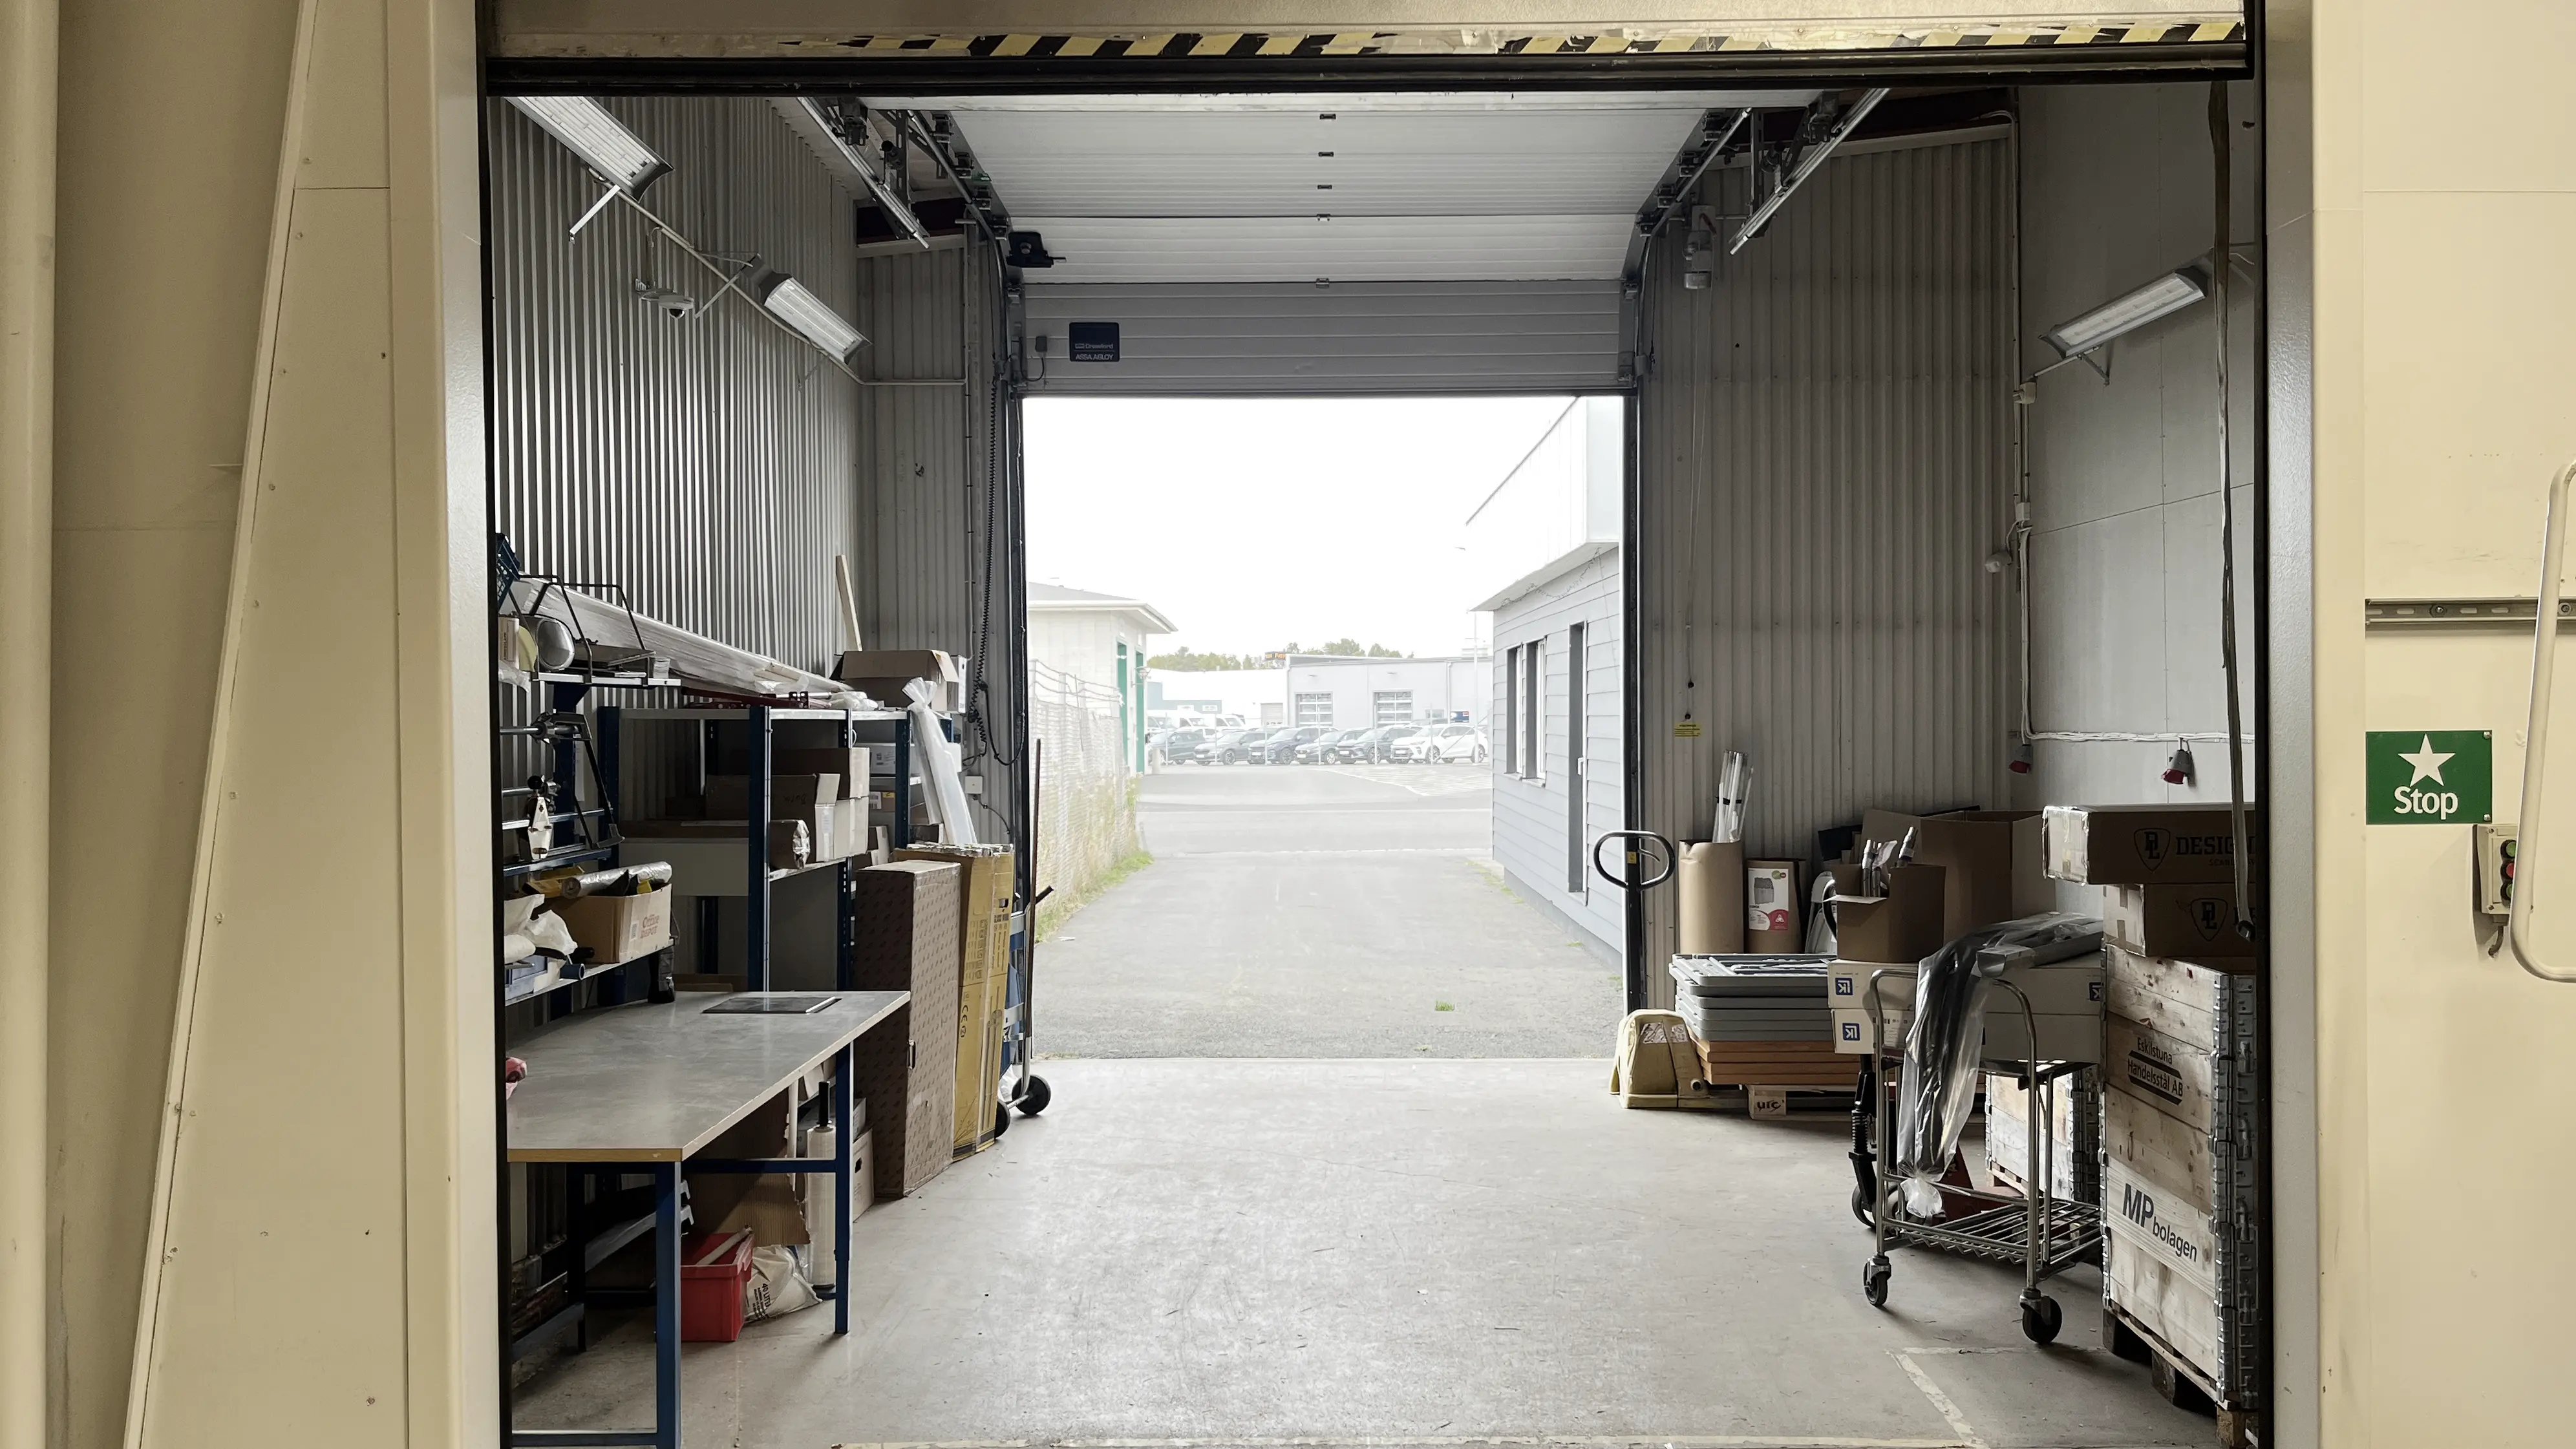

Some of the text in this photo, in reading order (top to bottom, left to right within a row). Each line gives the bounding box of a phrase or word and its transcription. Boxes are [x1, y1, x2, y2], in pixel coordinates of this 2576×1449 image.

[2394, 786, 2458, 820] Stop
[2137, 1037, 2173, 1065] Eskilstuna
[2127, 1057, 2183, 1097] Handelsstål AB
[2122, 1183, 2197, 1262] MP bolagen
[762, 1283, 769, 1292] 40
